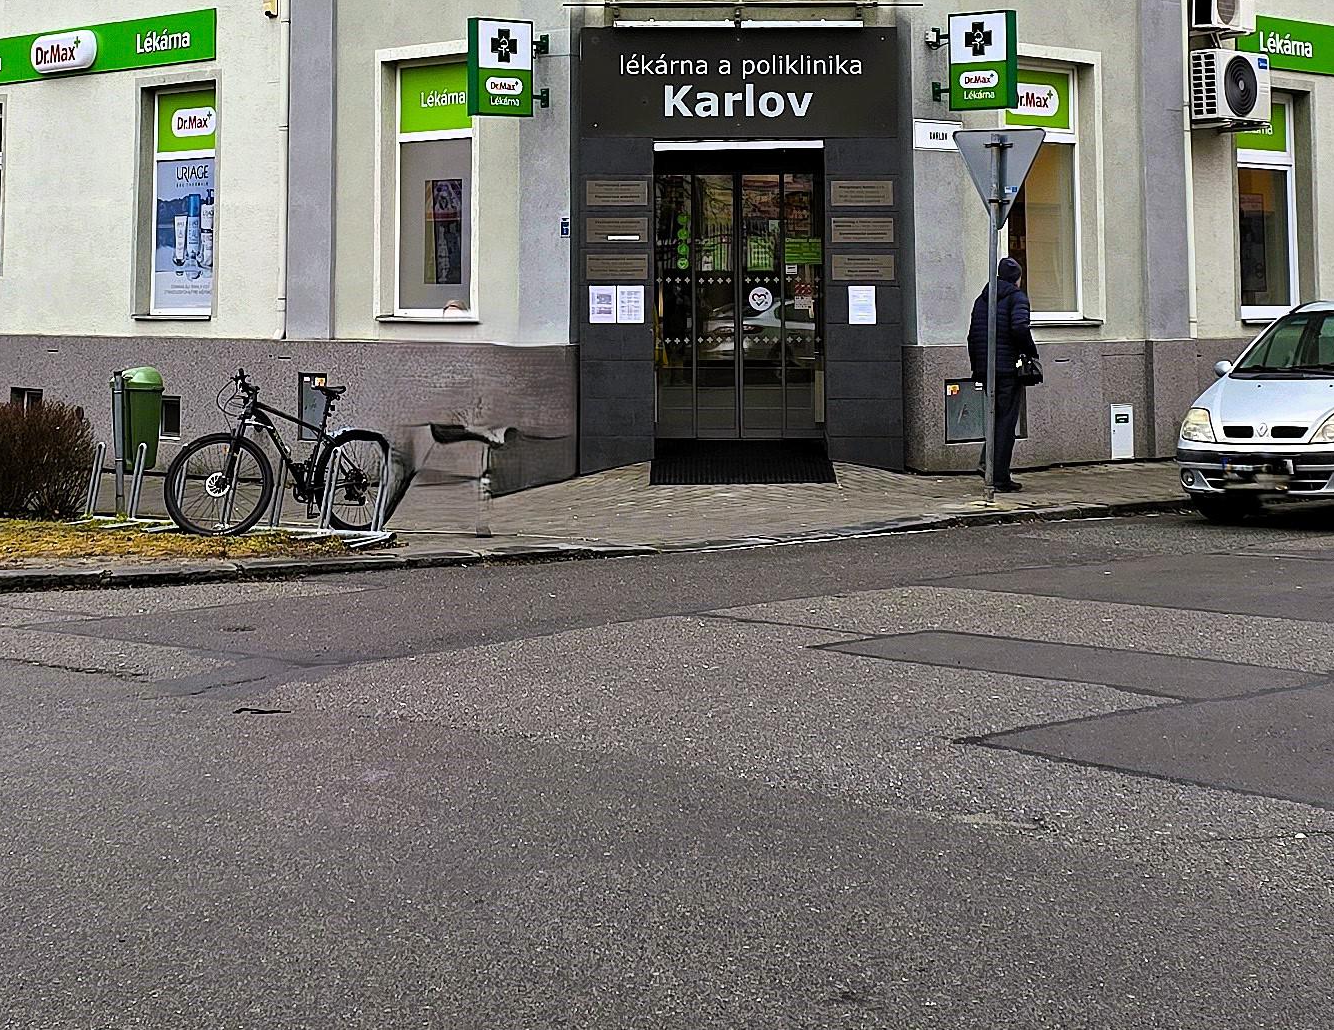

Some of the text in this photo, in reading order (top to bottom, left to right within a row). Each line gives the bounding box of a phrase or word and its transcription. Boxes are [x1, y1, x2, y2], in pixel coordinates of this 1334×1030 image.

[135, 28, 191, 54] Lékárna
[1259, 31, 1312, 58] Lékárna
[619, 53, 863, 80] lékárna a poliklinika
[420, 89, 465, 107] Lékárna
[663, 83, 814, 118] Karlov
